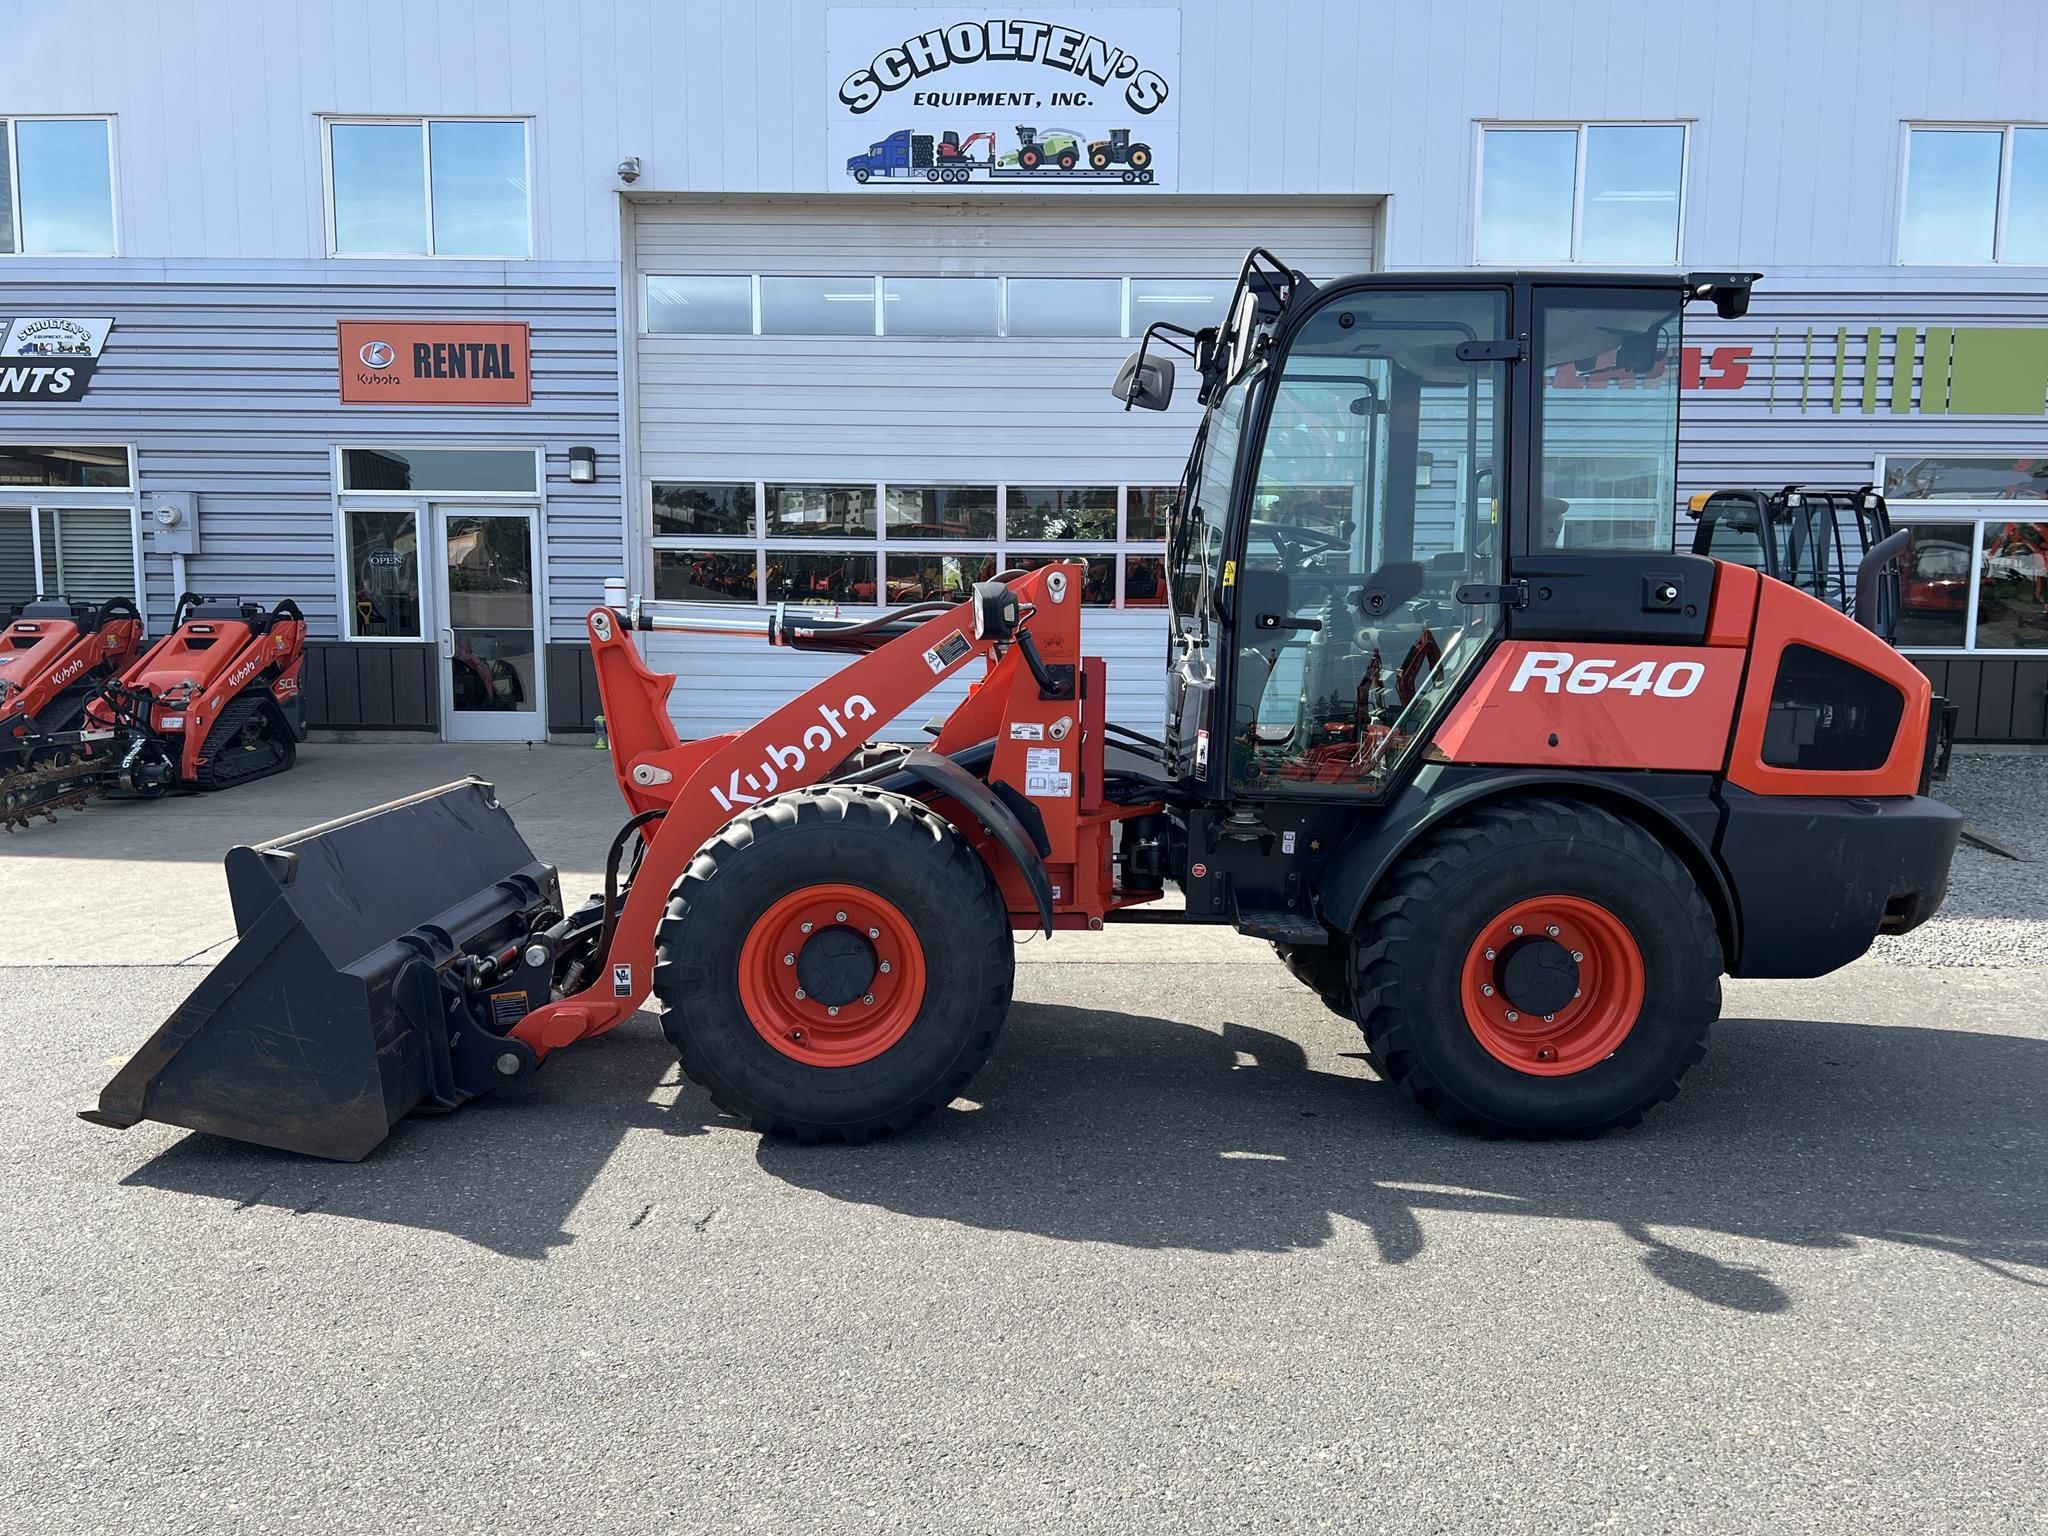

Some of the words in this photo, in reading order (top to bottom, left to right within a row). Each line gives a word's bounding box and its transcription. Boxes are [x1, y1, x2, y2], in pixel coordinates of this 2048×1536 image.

[838, 20, 1169, 115] SCHOLTEN'S
[913, 92, 1042, 108] EQUIPMENT,
[1050, 92, 1094, 107] INC.
[413, 343, 515, 379] RENTAL
[357, 373, 401, 385] Kubota
[370, 556, 402, 565] OPEN
[51, 659, 83, 685] Kubota
[228, 661, 256, 687] Kubota
[1508, 651, 1706, 698] R640
[710, 694, 877, 812] Kubota
